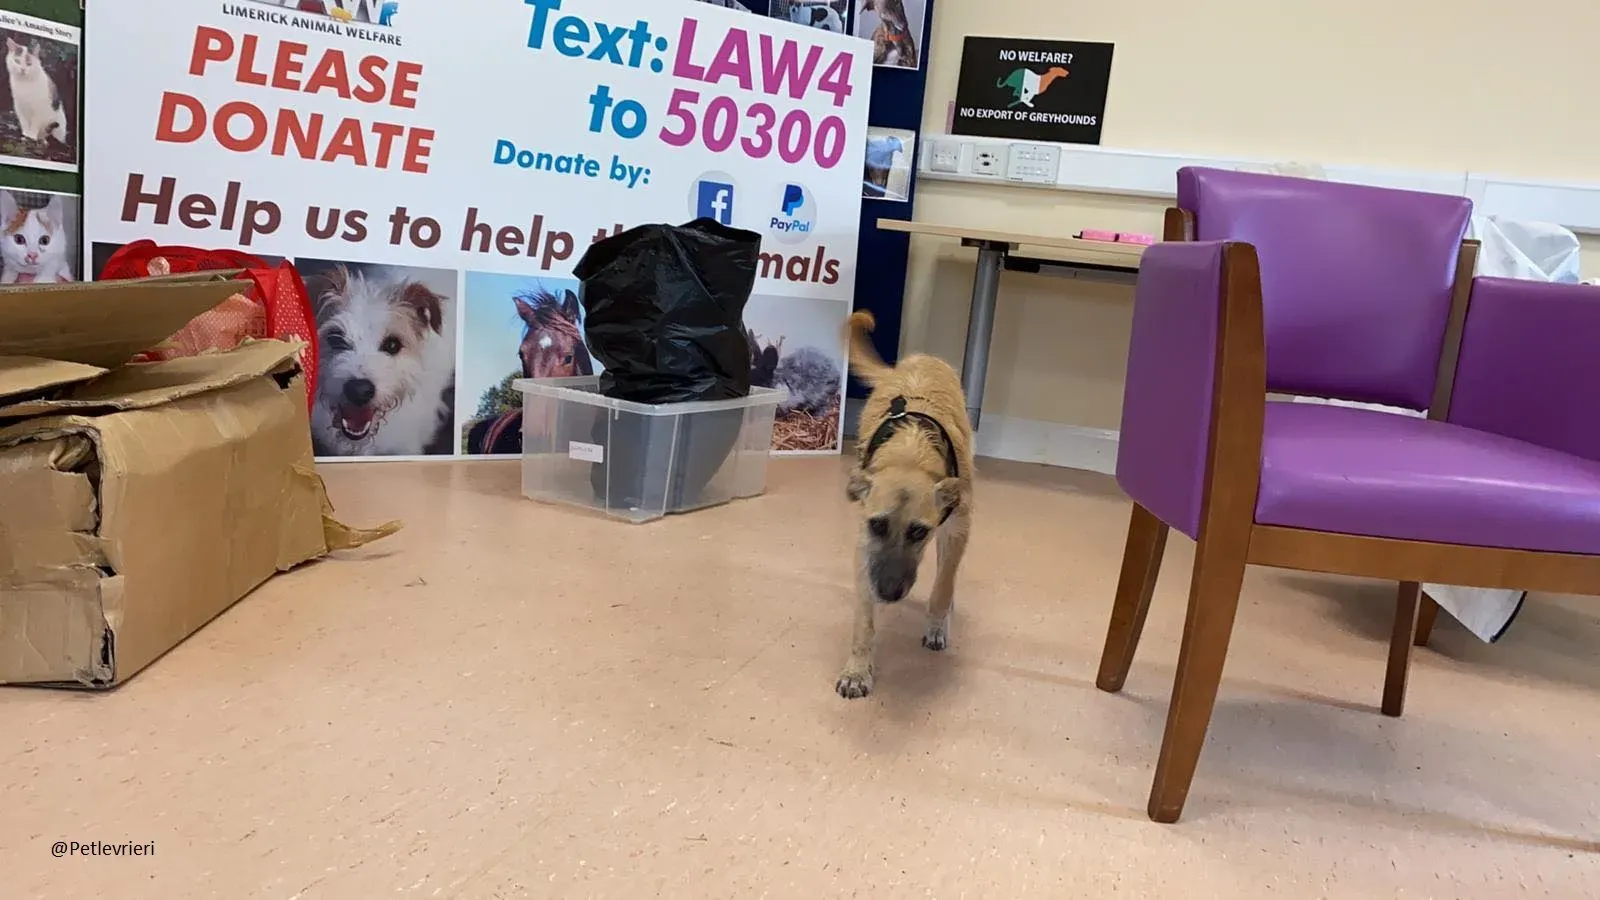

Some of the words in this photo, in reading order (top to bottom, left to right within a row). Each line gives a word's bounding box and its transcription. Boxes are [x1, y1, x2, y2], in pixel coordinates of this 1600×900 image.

[0, 15, 22, 26] lice's
[223, 4, 288, 26] LIMERICK
[291, 16, 342, 36] ANIMAL
[346, 26, 402, 46] WELFARE
[189, 25, 422, 108] PLEASE
[524, 0, 669, 74] Text:
[672, 18, 853, 107] LAW4
[1000, 50, 1017, 61] NO
[1018, 51, 1074, 64] WELFARE?
[155, 91, 435, 174] DONATE
[589, 84, 648, 140] to
[659, 88, 846, 170] 50300
[960, 107, 975, 118] NO
[976, 108, 1014, 121] EXPORT
[1014, 111, 1028, 121] OF
[1029, 111, 1097, 126] GREYHOUNDS
[493, 139, 601, 178] Donate
[608, 154, 651, 190] by:
[120, 172, 282, 246] Help
[305, 206, 369, 243] us
[389, 206, 442, 249] to
[460, 207, 574, 271] help
[757, 245, 841, 285] mals
[770, 217, 810, 233] PayPal
